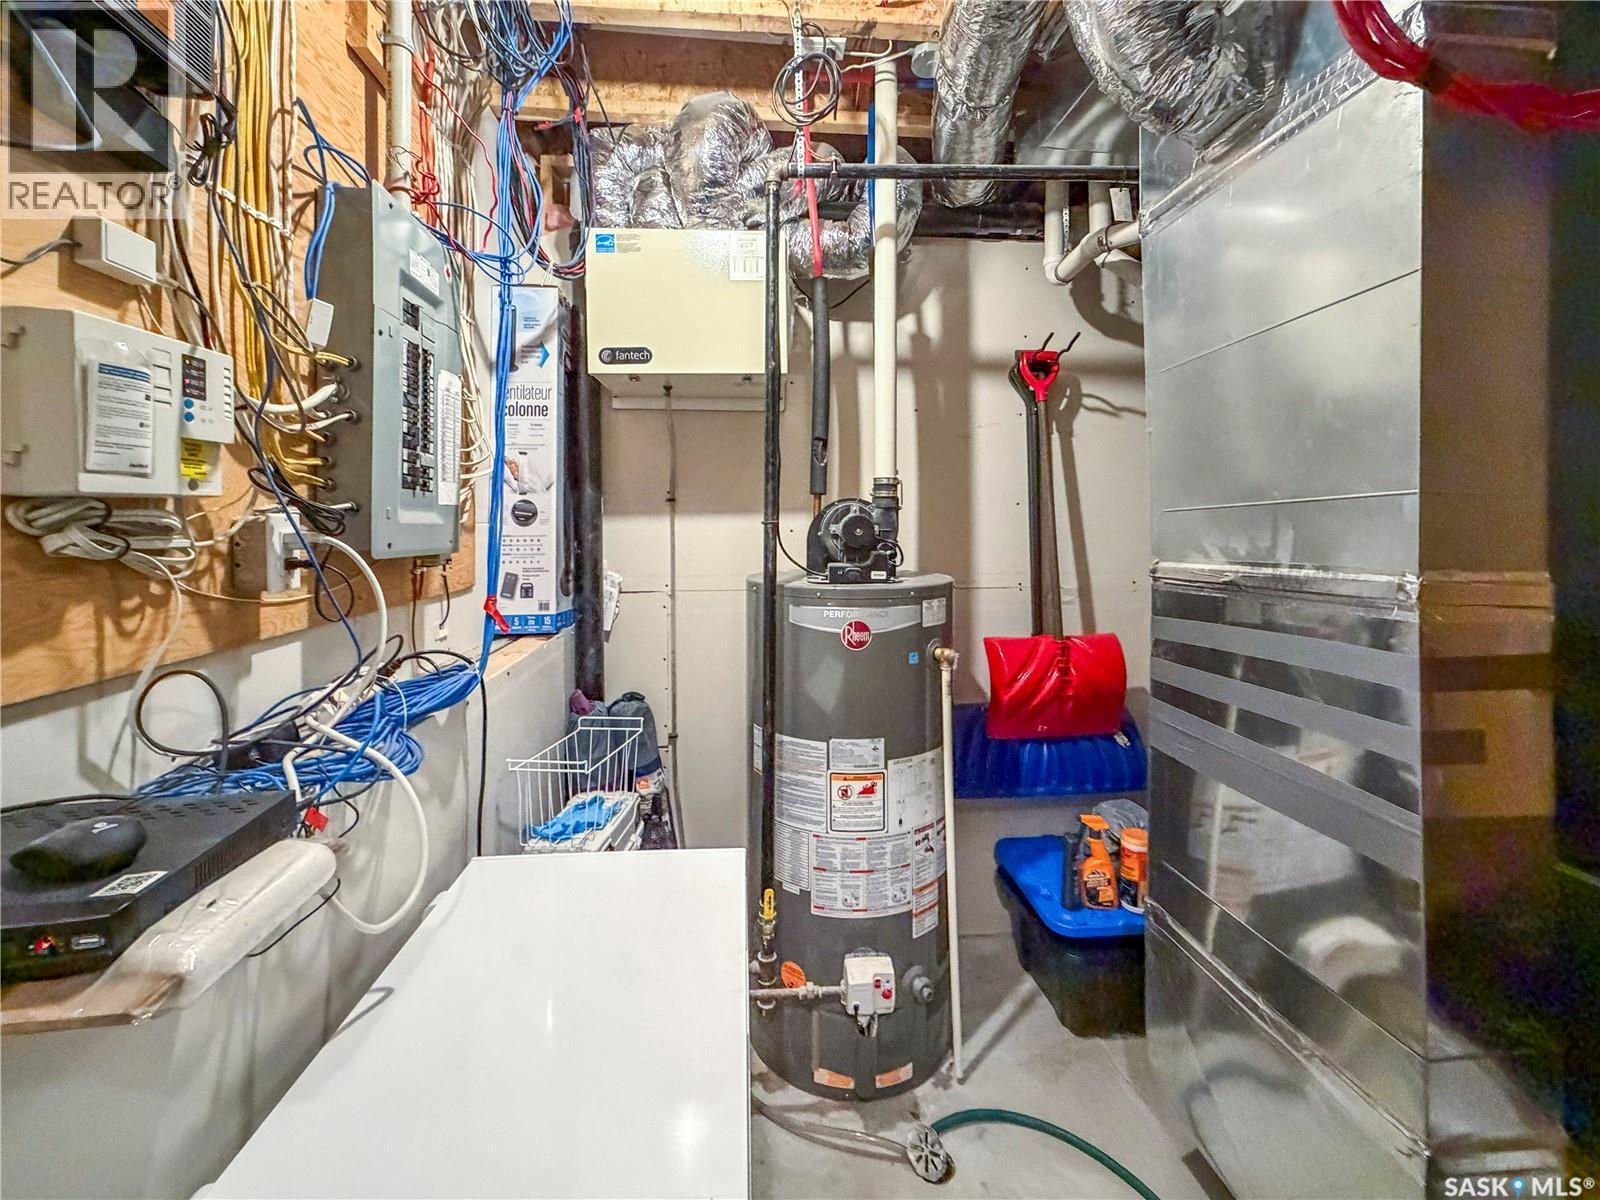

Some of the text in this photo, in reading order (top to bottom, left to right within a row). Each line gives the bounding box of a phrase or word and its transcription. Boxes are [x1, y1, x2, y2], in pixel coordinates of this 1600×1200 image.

[615, 350, 650, 360] fantech
[507, 384, 552, 400] entilateur
[844, 621, 870, 646] Rheem
